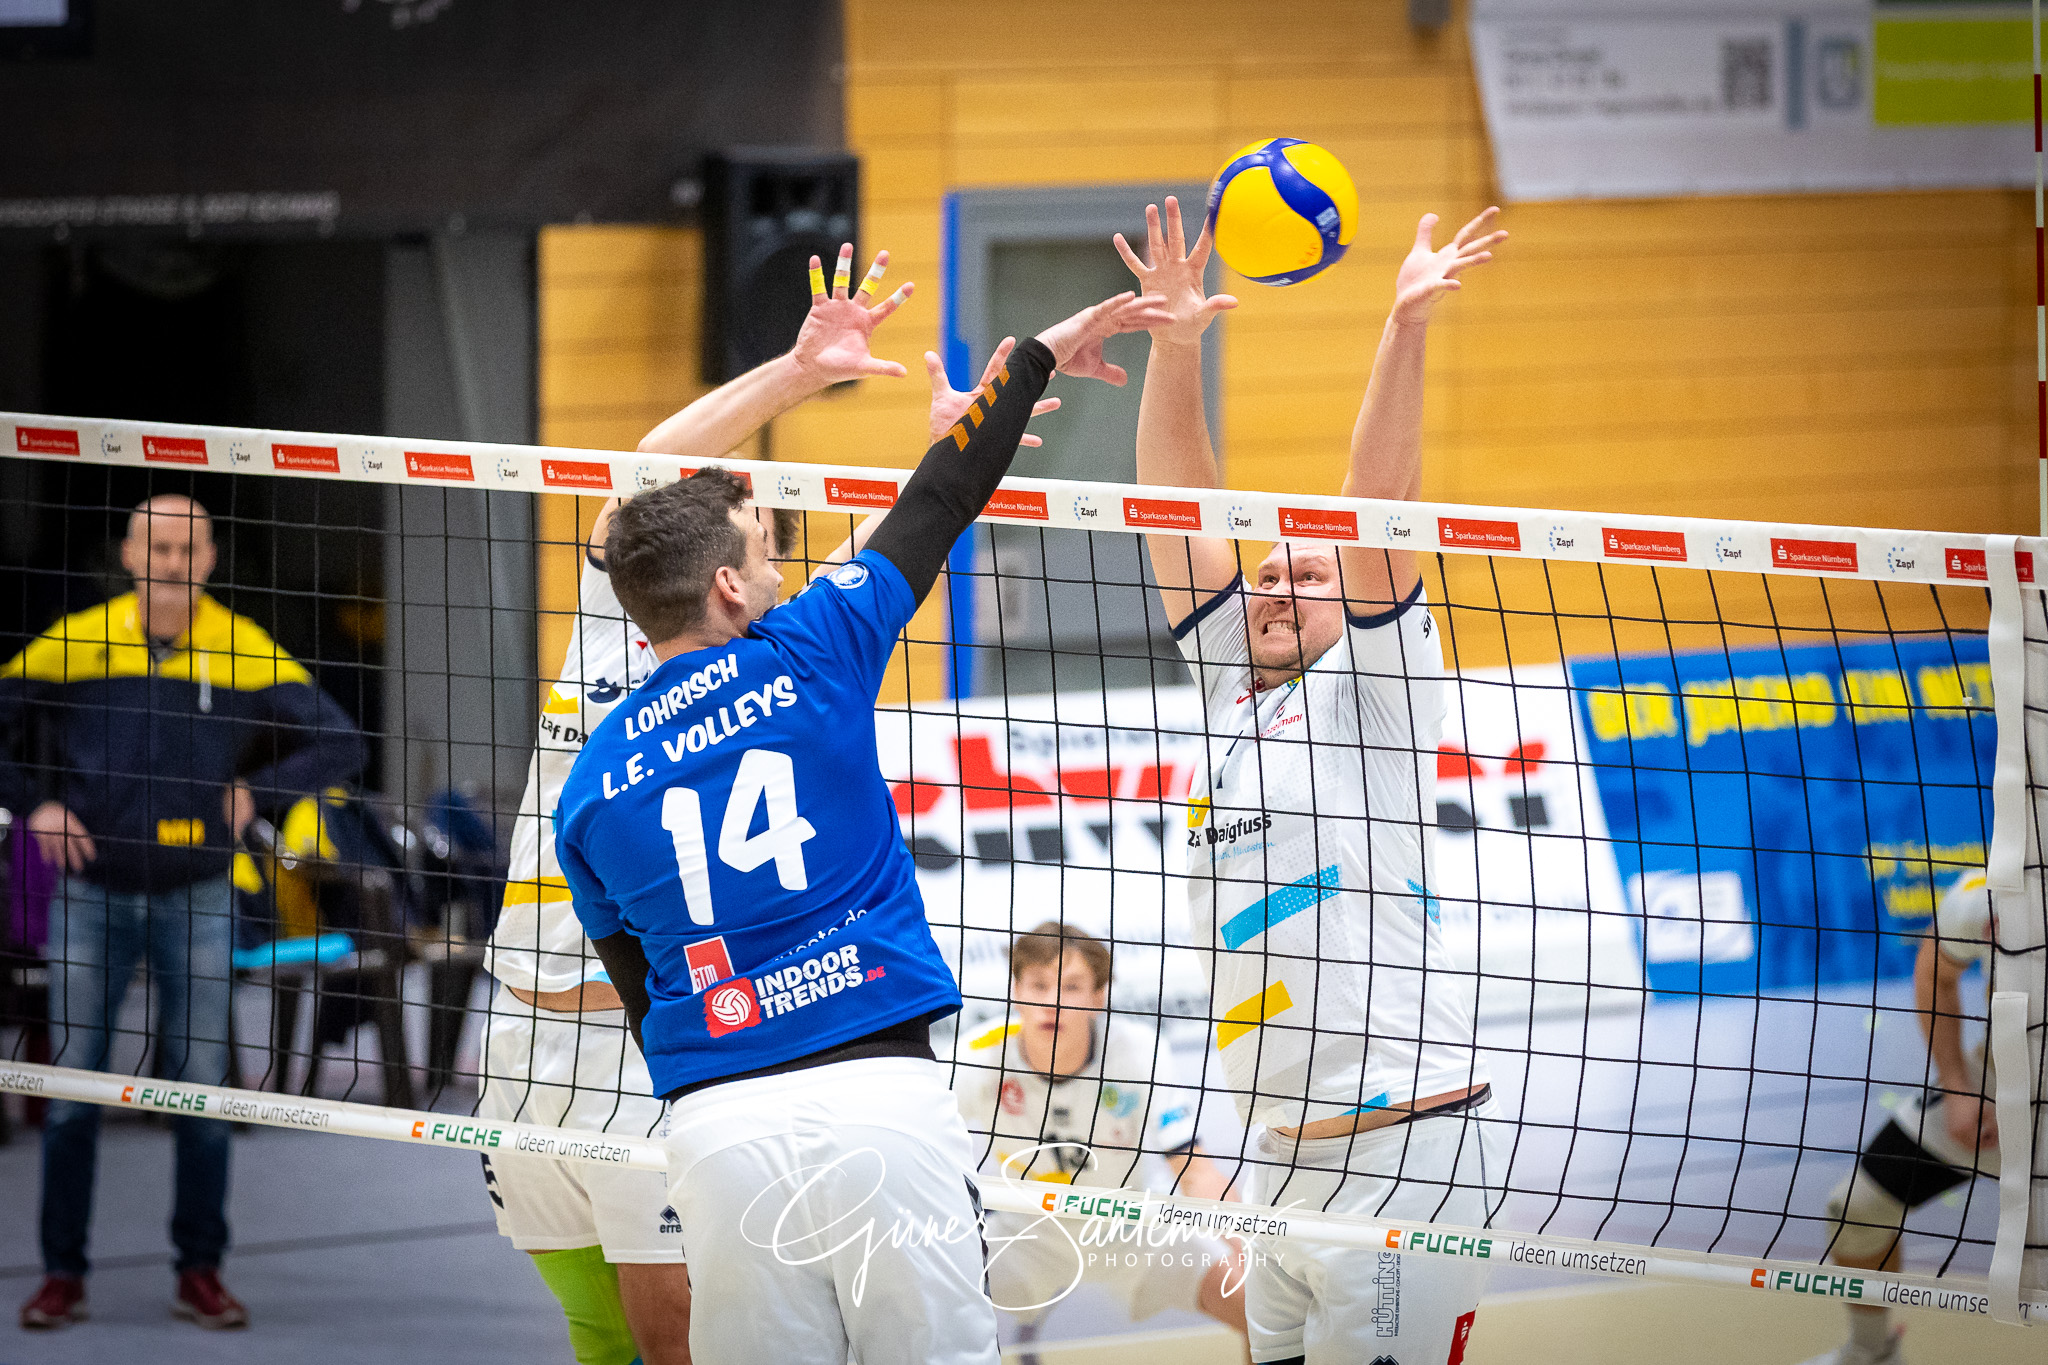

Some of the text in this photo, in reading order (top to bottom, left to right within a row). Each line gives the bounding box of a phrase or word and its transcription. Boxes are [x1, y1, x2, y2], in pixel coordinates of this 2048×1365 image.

[368, 461, 383, 470] Zapf
[503, 469, 518, 478] Zapf
[642, 477, 657, 486] Zapf
[784, 487, 801, 496] Zapf
[840, 490, 866, 500] Sparkasse
[867, 493, 894, 503] Nürnberg
[988, 501, 1043, 513] Sparkasse Nürnberg
[1080, 508, 1098, 517] Zapf
[1139, 511, 1167, 521] Sparkasse
[1168, 513, 1196, 523] Nürnberg
[1234, 518, 1252, 527] Zapf
[1295, 521, 1323, 531] Sparkasse
[1324, 523, 1352, 534] Nürnberg
[1393, 527, 1411, 537] Zapf
[1455, 531, 1485, 542] Sparkasse
[1486, 534, 1515, 545] Nürnberg
[1556, 538, 1574, 548] Zapf
[1620, 541, 1651, 551] Sparkasse
[1652, 543, 1681, 554] Nürnberg
[1723, 548, 1741, 559] Zapf
[1789, 552, 1821, 562] Sparkasse
[1822, 555, 1851, 566] Nürnberg
[1895, 559, 1915, 570] Zapf
[625, 653, 739, 741] LOHRISCH
[602, 675, 797, 800] L.E. VOLLEYS
[1205, 814, 1272, 845] Daigfuss
[661, 749, 816, 926] 14
[755, 944, 860, 998] INDOOR
[140, 1088, 207, 1111] FUCHS
[219, 1099, 257, 1119] Ideen
[261, 1104, 329, 1127] umsetzen
[431, 1124, 502, 1147] FUCHS
[514, 1131, 555, 1154] Ideen
[558, 1140, 630, 1163] umsetzen
[1064, 1195, 1143, 1220] FUCHS
[1158, 1203, 1203, 1227] Ideen
[1207, 1213, 1288, 1237] umsetzen
[660, 1224, 683, 1234] erre
[1409, 1232, 1493, 1258] FUCHS
[1509, 1241, 1556, 1265] Ideen
[1561, 1251, 1647, 1276] umsetzen
[1776, 1271, 1864, 1299] FUCHS
[1882, 1281, 1931, 1308] Ideen
